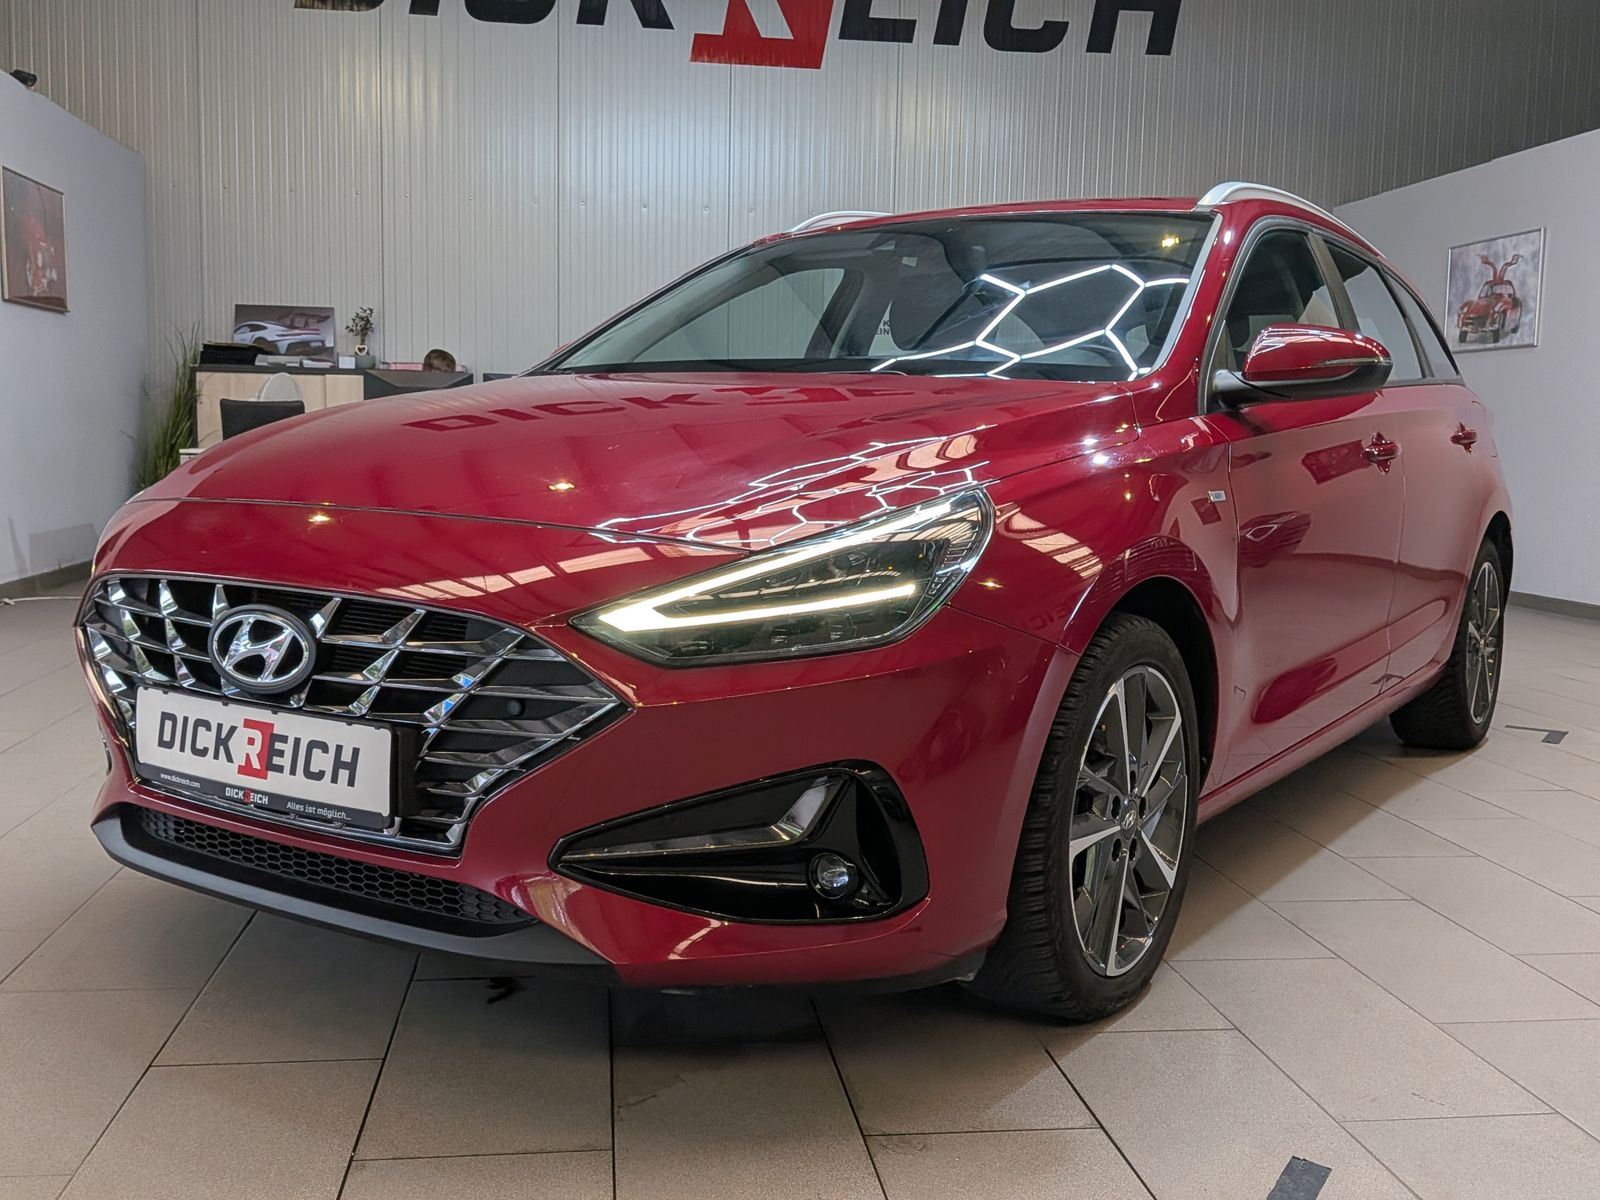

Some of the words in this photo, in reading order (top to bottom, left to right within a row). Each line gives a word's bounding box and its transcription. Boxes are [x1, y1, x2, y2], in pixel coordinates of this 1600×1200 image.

[157, 711, 361, 788] DICKREICH
[225, 787, 269, 805] DICKREICH
[286, 801, 305, 813] Alles
[305, 804, 316, 814] ist
